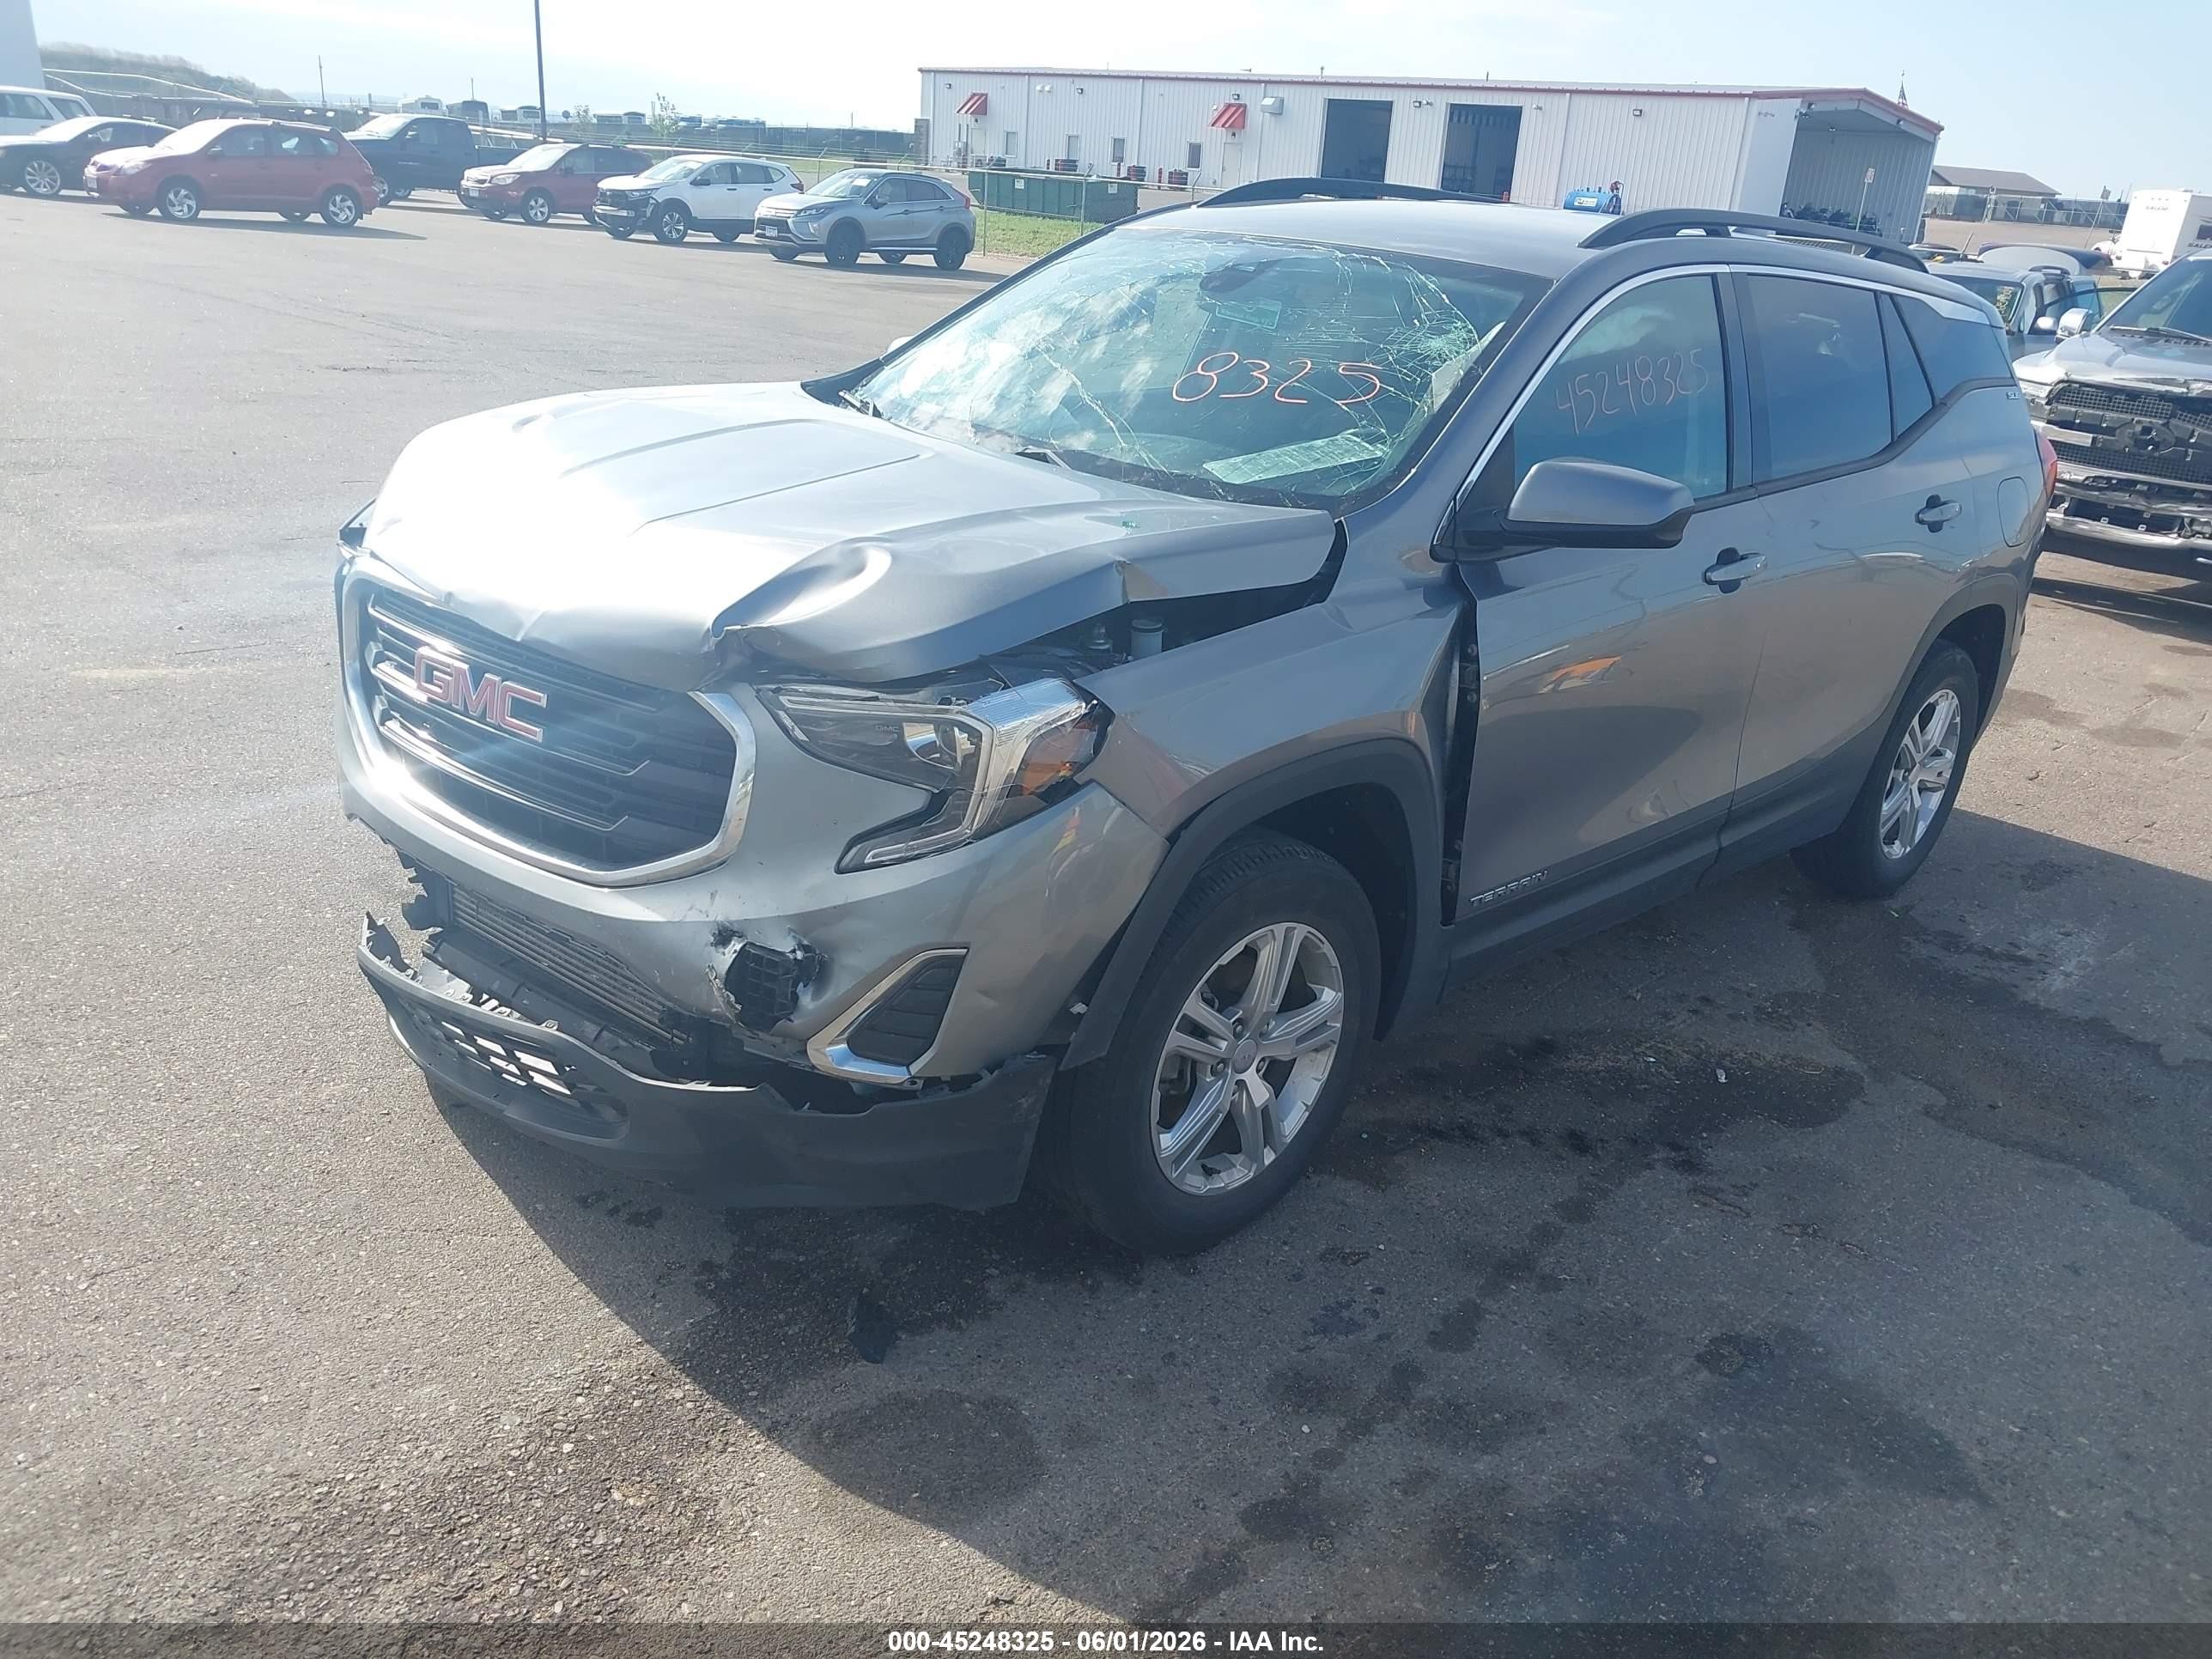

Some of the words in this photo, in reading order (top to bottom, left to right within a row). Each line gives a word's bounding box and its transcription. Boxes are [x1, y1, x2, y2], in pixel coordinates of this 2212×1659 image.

[1172, 351, 1383, 403] 8325
[1555, 348, 1709, 435] 45248325
[415, 645, 548, 743] GMC
[1469, 869, 1549, 908] TERRAIN
